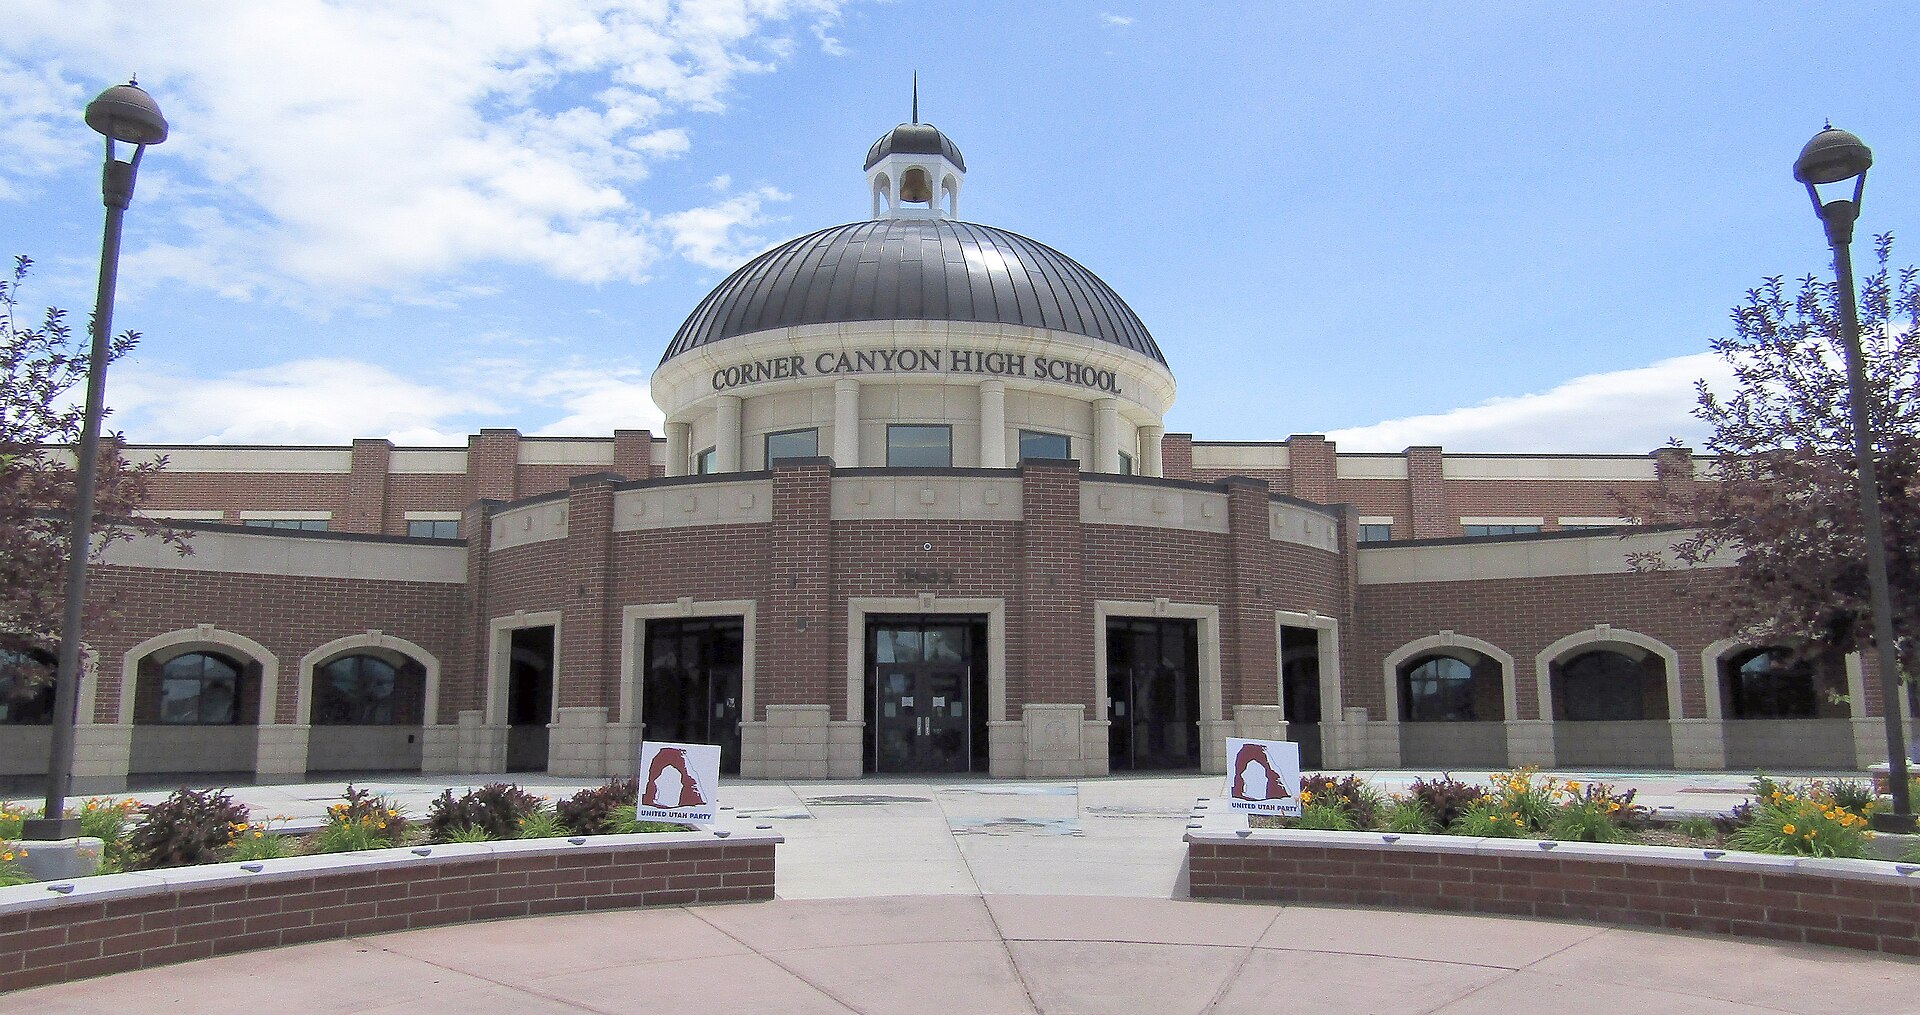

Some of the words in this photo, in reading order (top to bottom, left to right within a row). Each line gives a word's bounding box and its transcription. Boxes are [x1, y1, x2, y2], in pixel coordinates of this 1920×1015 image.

[712, 355, 807, 391] CORNER
[815, 349, 941, 374] CANYON
[950, 350, 1026, 376] HIGH
[1034, 357, 1122, 394] SCHOOL
[1231, 802, 1256, 810] UNITED
[641, 810, 667, 818] UNITED
[669, 811, 688, 819] UTAH
